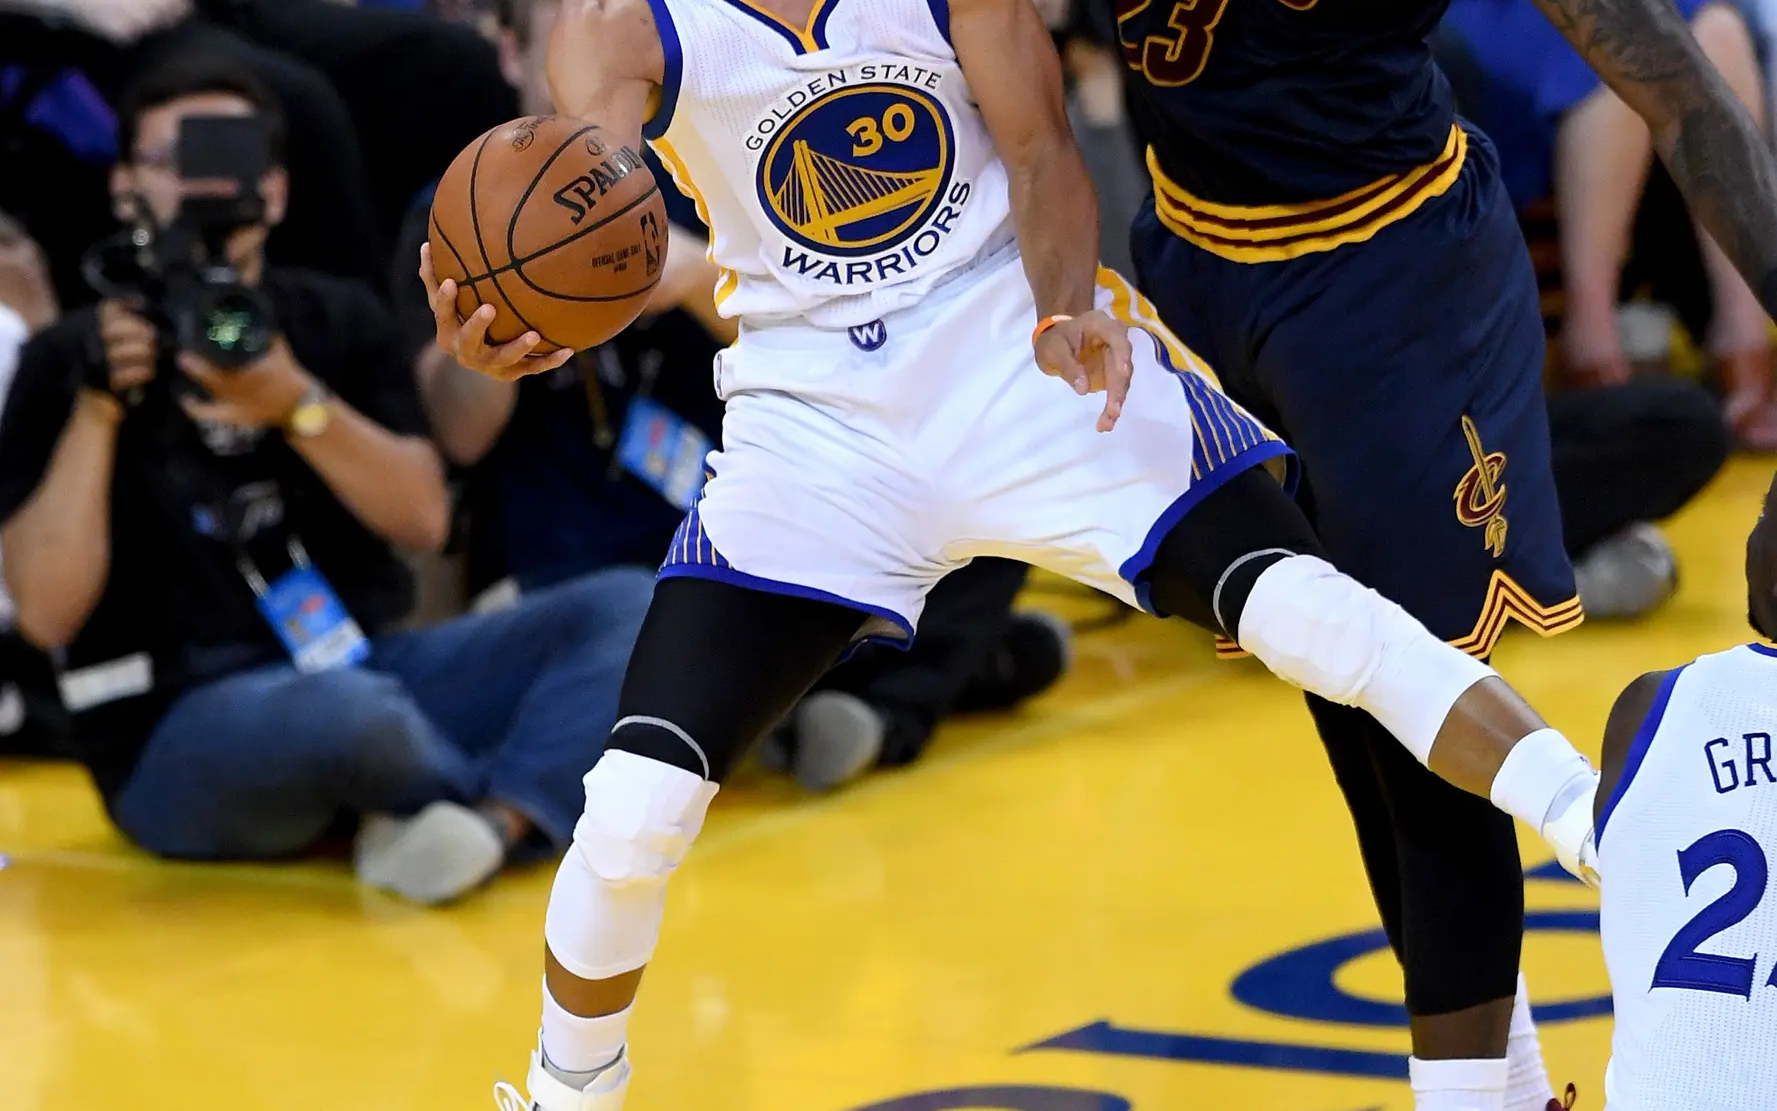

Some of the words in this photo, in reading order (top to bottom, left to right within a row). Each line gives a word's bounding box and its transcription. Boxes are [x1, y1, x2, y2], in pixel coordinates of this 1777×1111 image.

[745, 69, 848, 152] GOLDEN
[860, 64, 943, 90] STATE
[845, 102, 916, 158] 30
[782, 181, 971, 286] WARRIORS
[852, 322, 880, 345] W
[1649, 828, 1777, 1003] 2
